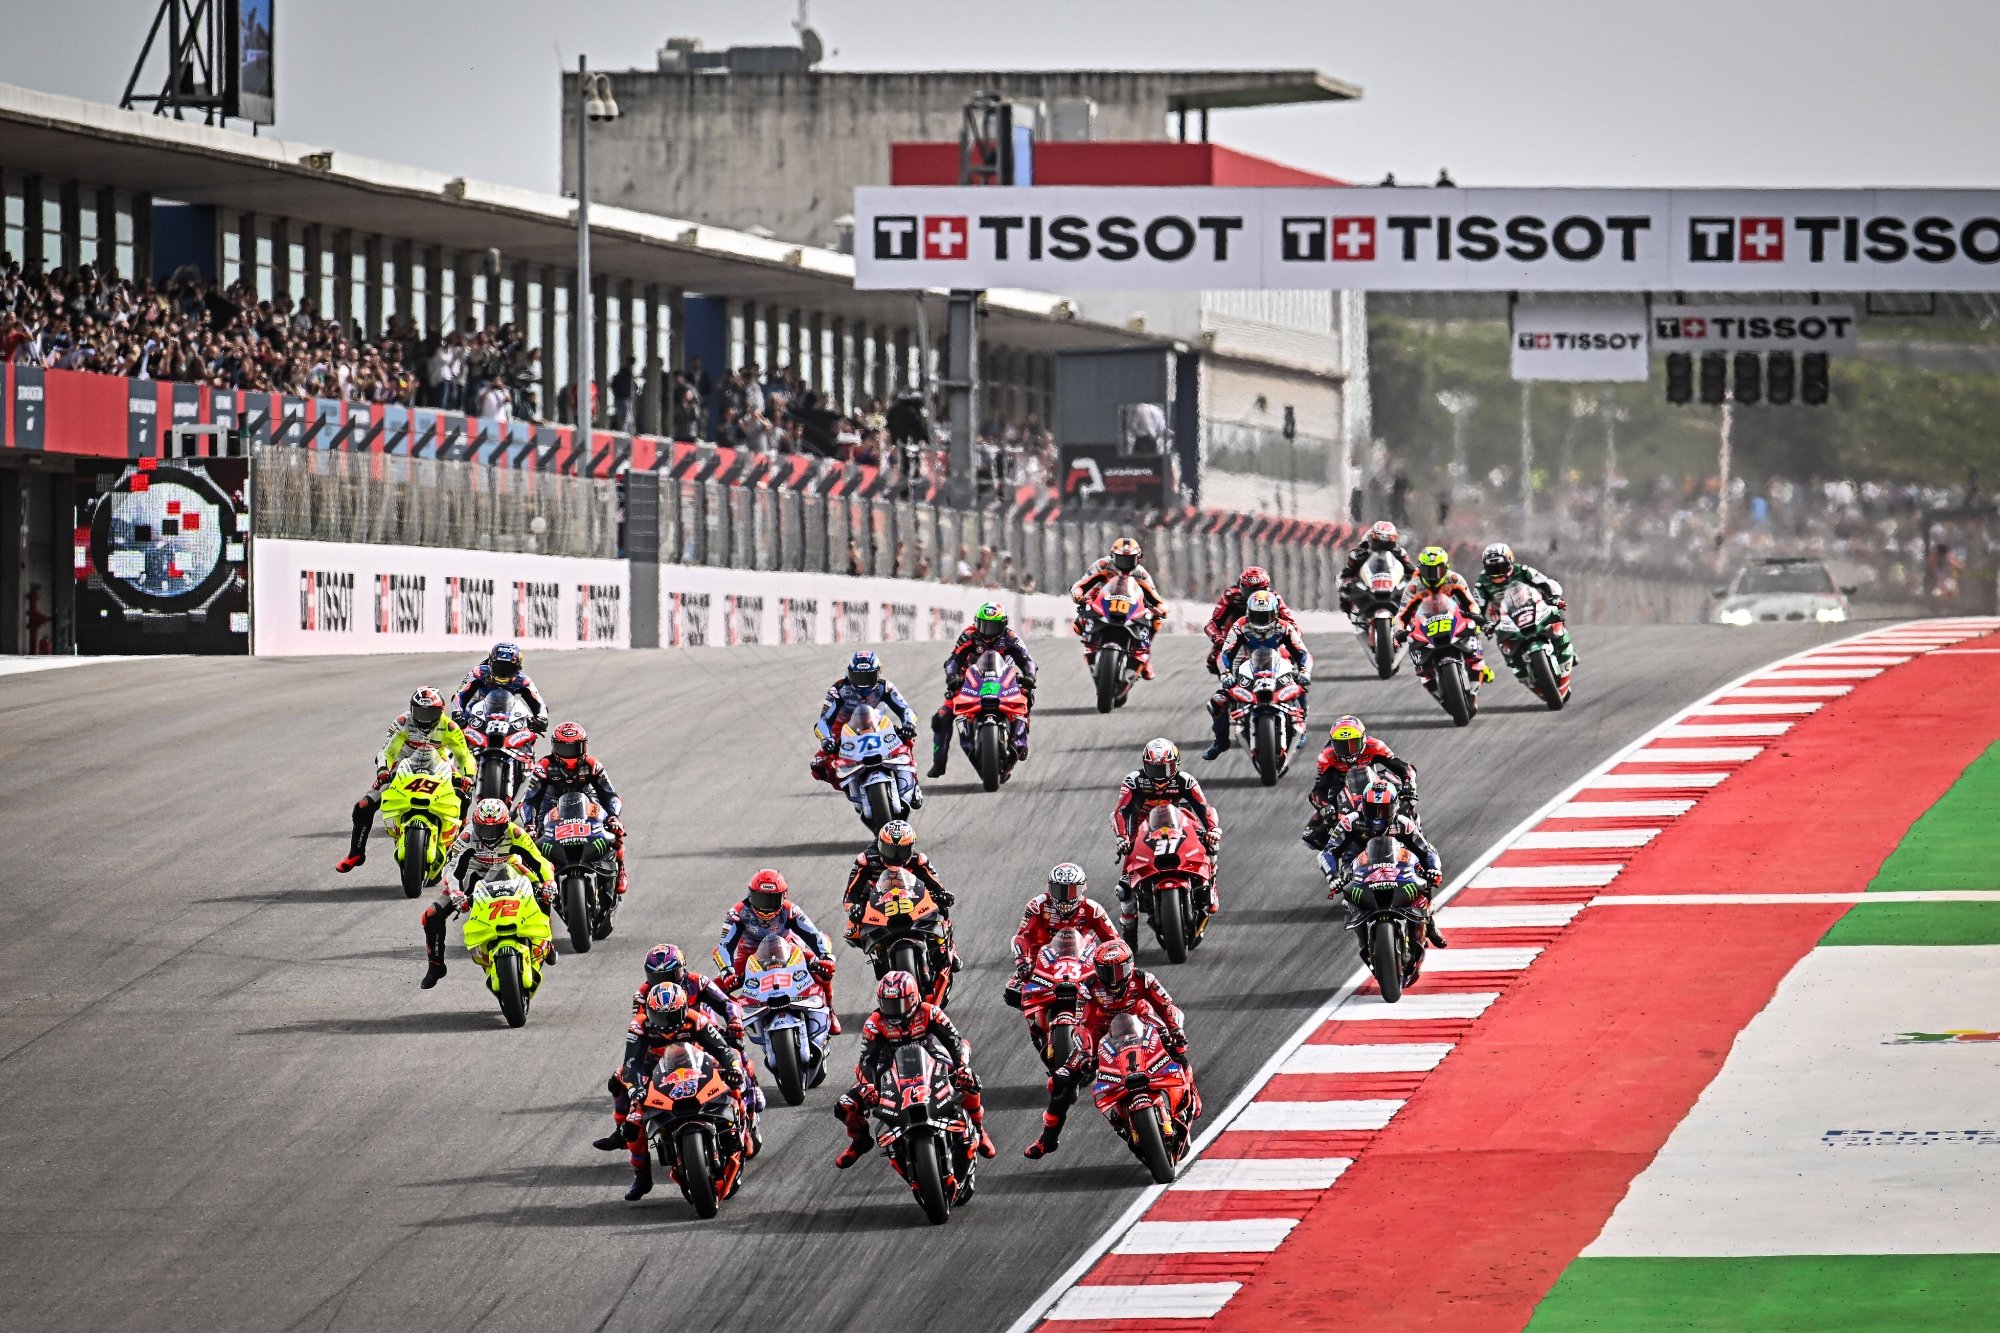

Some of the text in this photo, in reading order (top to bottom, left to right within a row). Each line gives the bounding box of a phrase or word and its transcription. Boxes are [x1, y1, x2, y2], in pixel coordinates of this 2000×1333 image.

[980, 216, 1243, 261] TISSOT
[1387, 216, 1651, 261] TISSOT
[1711, 316, 1852, 339] TISSOT
[1554, 332, 1642, 350] TISSOT
[1109, 599, 1130, 614] 10
[1427, 619, 1452, 637] 36
[404, 778, 441, 795] 49
[555, 822, 591, 841] 20
[489, 900, 520, 921] 72
[1054, 961, 1082, 980] 23
[760, 972, 792, 993] 93
[1031, 974, 1053, 988] Lenovo
[1126, 1051, 1137, 1073] 1
[1148, 1055, 1171, 1075] Lenovo
[1098, 1073, 1122, 1083] Lenovo
